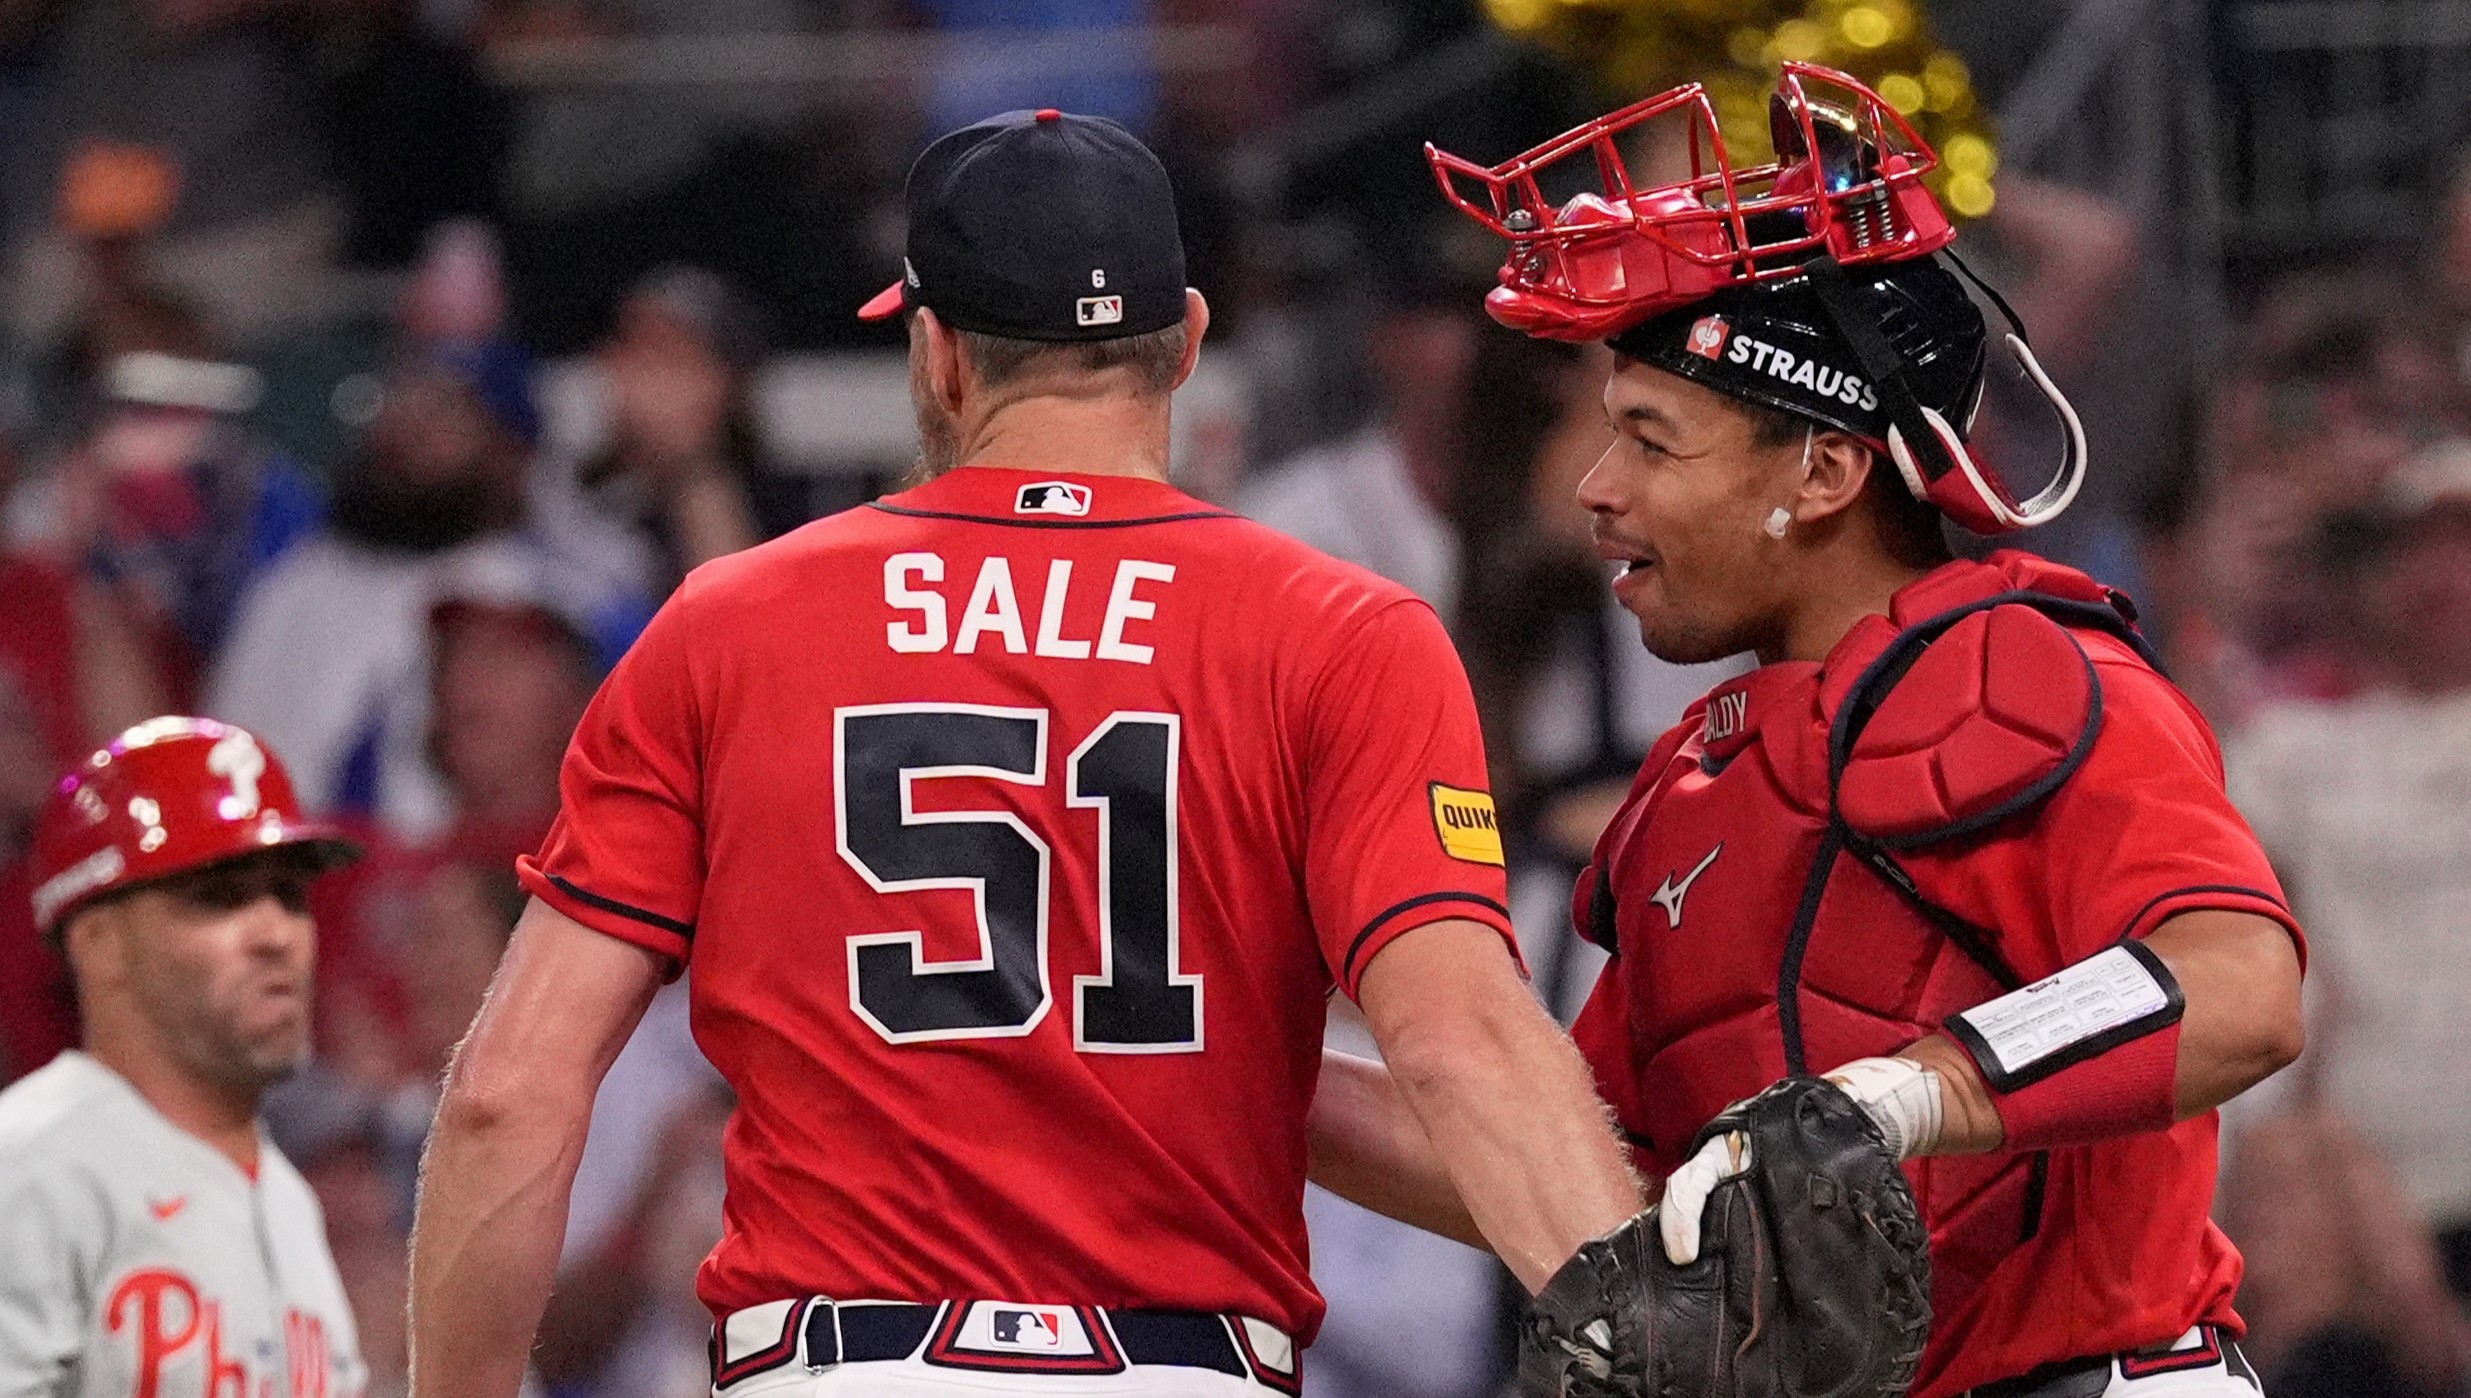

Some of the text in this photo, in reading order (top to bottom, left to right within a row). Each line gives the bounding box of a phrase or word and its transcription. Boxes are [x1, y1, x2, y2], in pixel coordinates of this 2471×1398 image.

[1092, 269, 1105, 288] 6
[1728, 335, 1878, 411] STRAUSS
[884, 552, 1176, 665] SALE
[1703, 690, 1747, 744] ALDY
[1443, 803, 1496, 831] QUIK
[834, 702, 1204, 1054] 51
